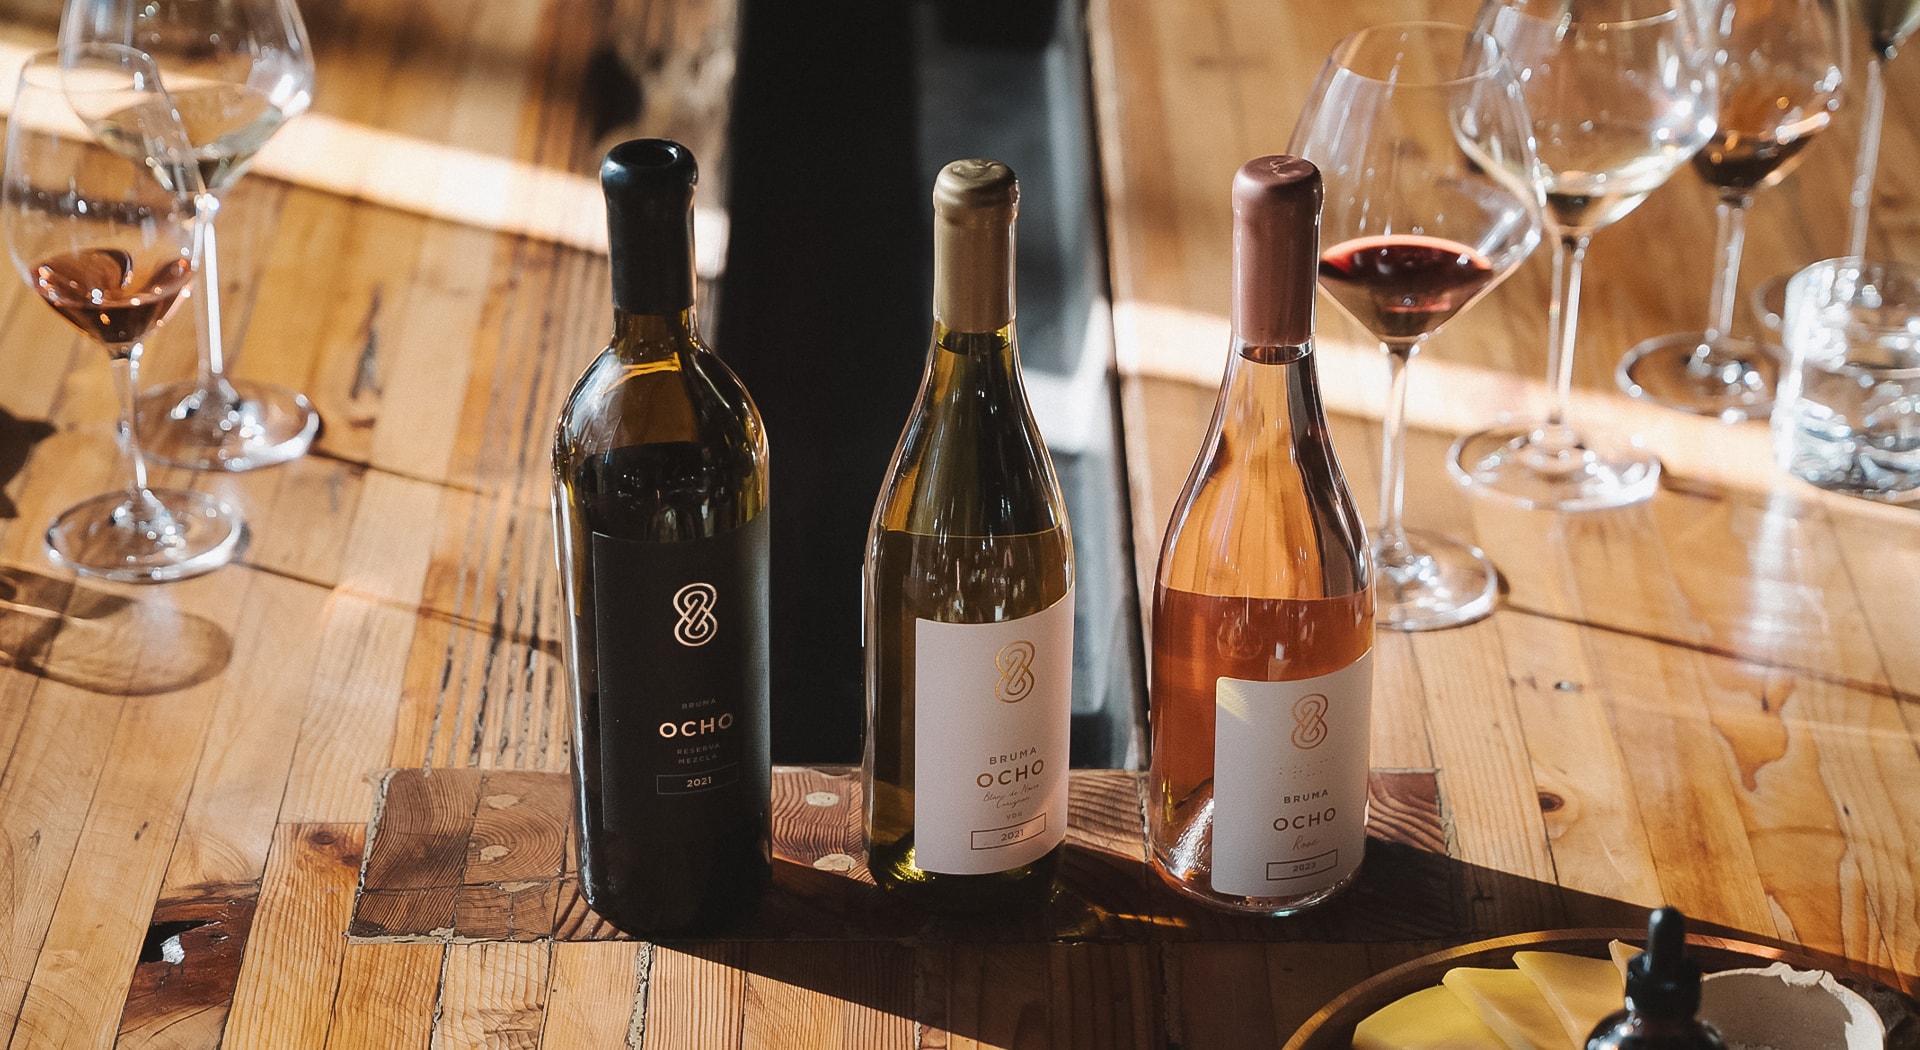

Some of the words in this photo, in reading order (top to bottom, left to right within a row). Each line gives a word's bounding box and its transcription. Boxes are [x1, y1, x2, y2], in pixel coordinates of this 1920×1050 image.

[681, 697, 717, 710] BRUMA
[659, 713, 733, 738] OCHO
[676, 743, 721, 755] RESERVA
[989, 746, 1037, 765] BRUMA
[678, 753, 718, 765] MEZCLA
[976, 759, 1044, 788] OCHO
[686, 776, 712, 788] 2021
[1284, 789, 1329, 804] BRUMA
[1273, 807, 1336, 832] OCHO
[1000, 829, 1024, 842] 2021
[1292, 861, 1317, 872] 2023
